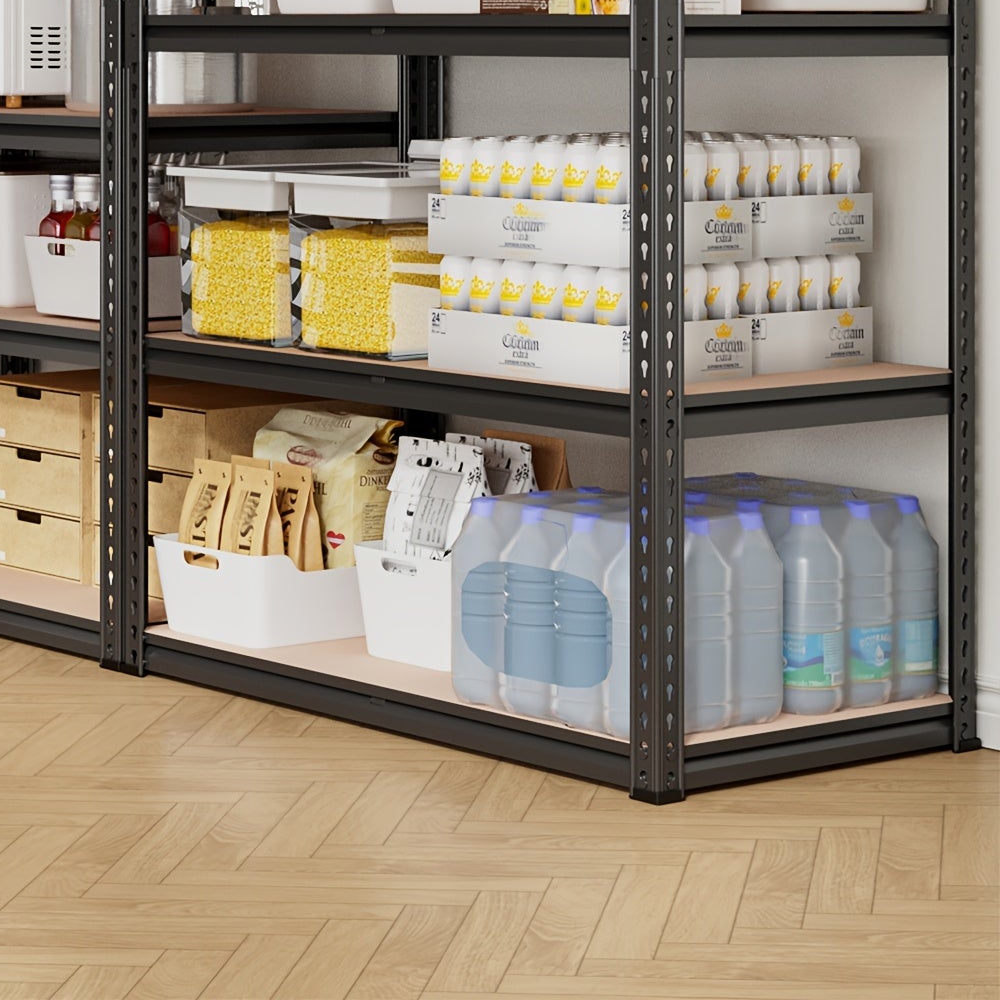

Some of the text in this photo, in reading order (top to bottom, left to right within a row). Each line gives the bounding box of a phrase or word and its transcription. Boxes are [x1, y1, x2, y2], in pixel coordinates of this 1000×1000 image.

[431, 197, 441, 208] 24
[751, 202, 761, 212] 24
[431, 312, 441, 322] 24
[751, 318, 761, 329] 24
